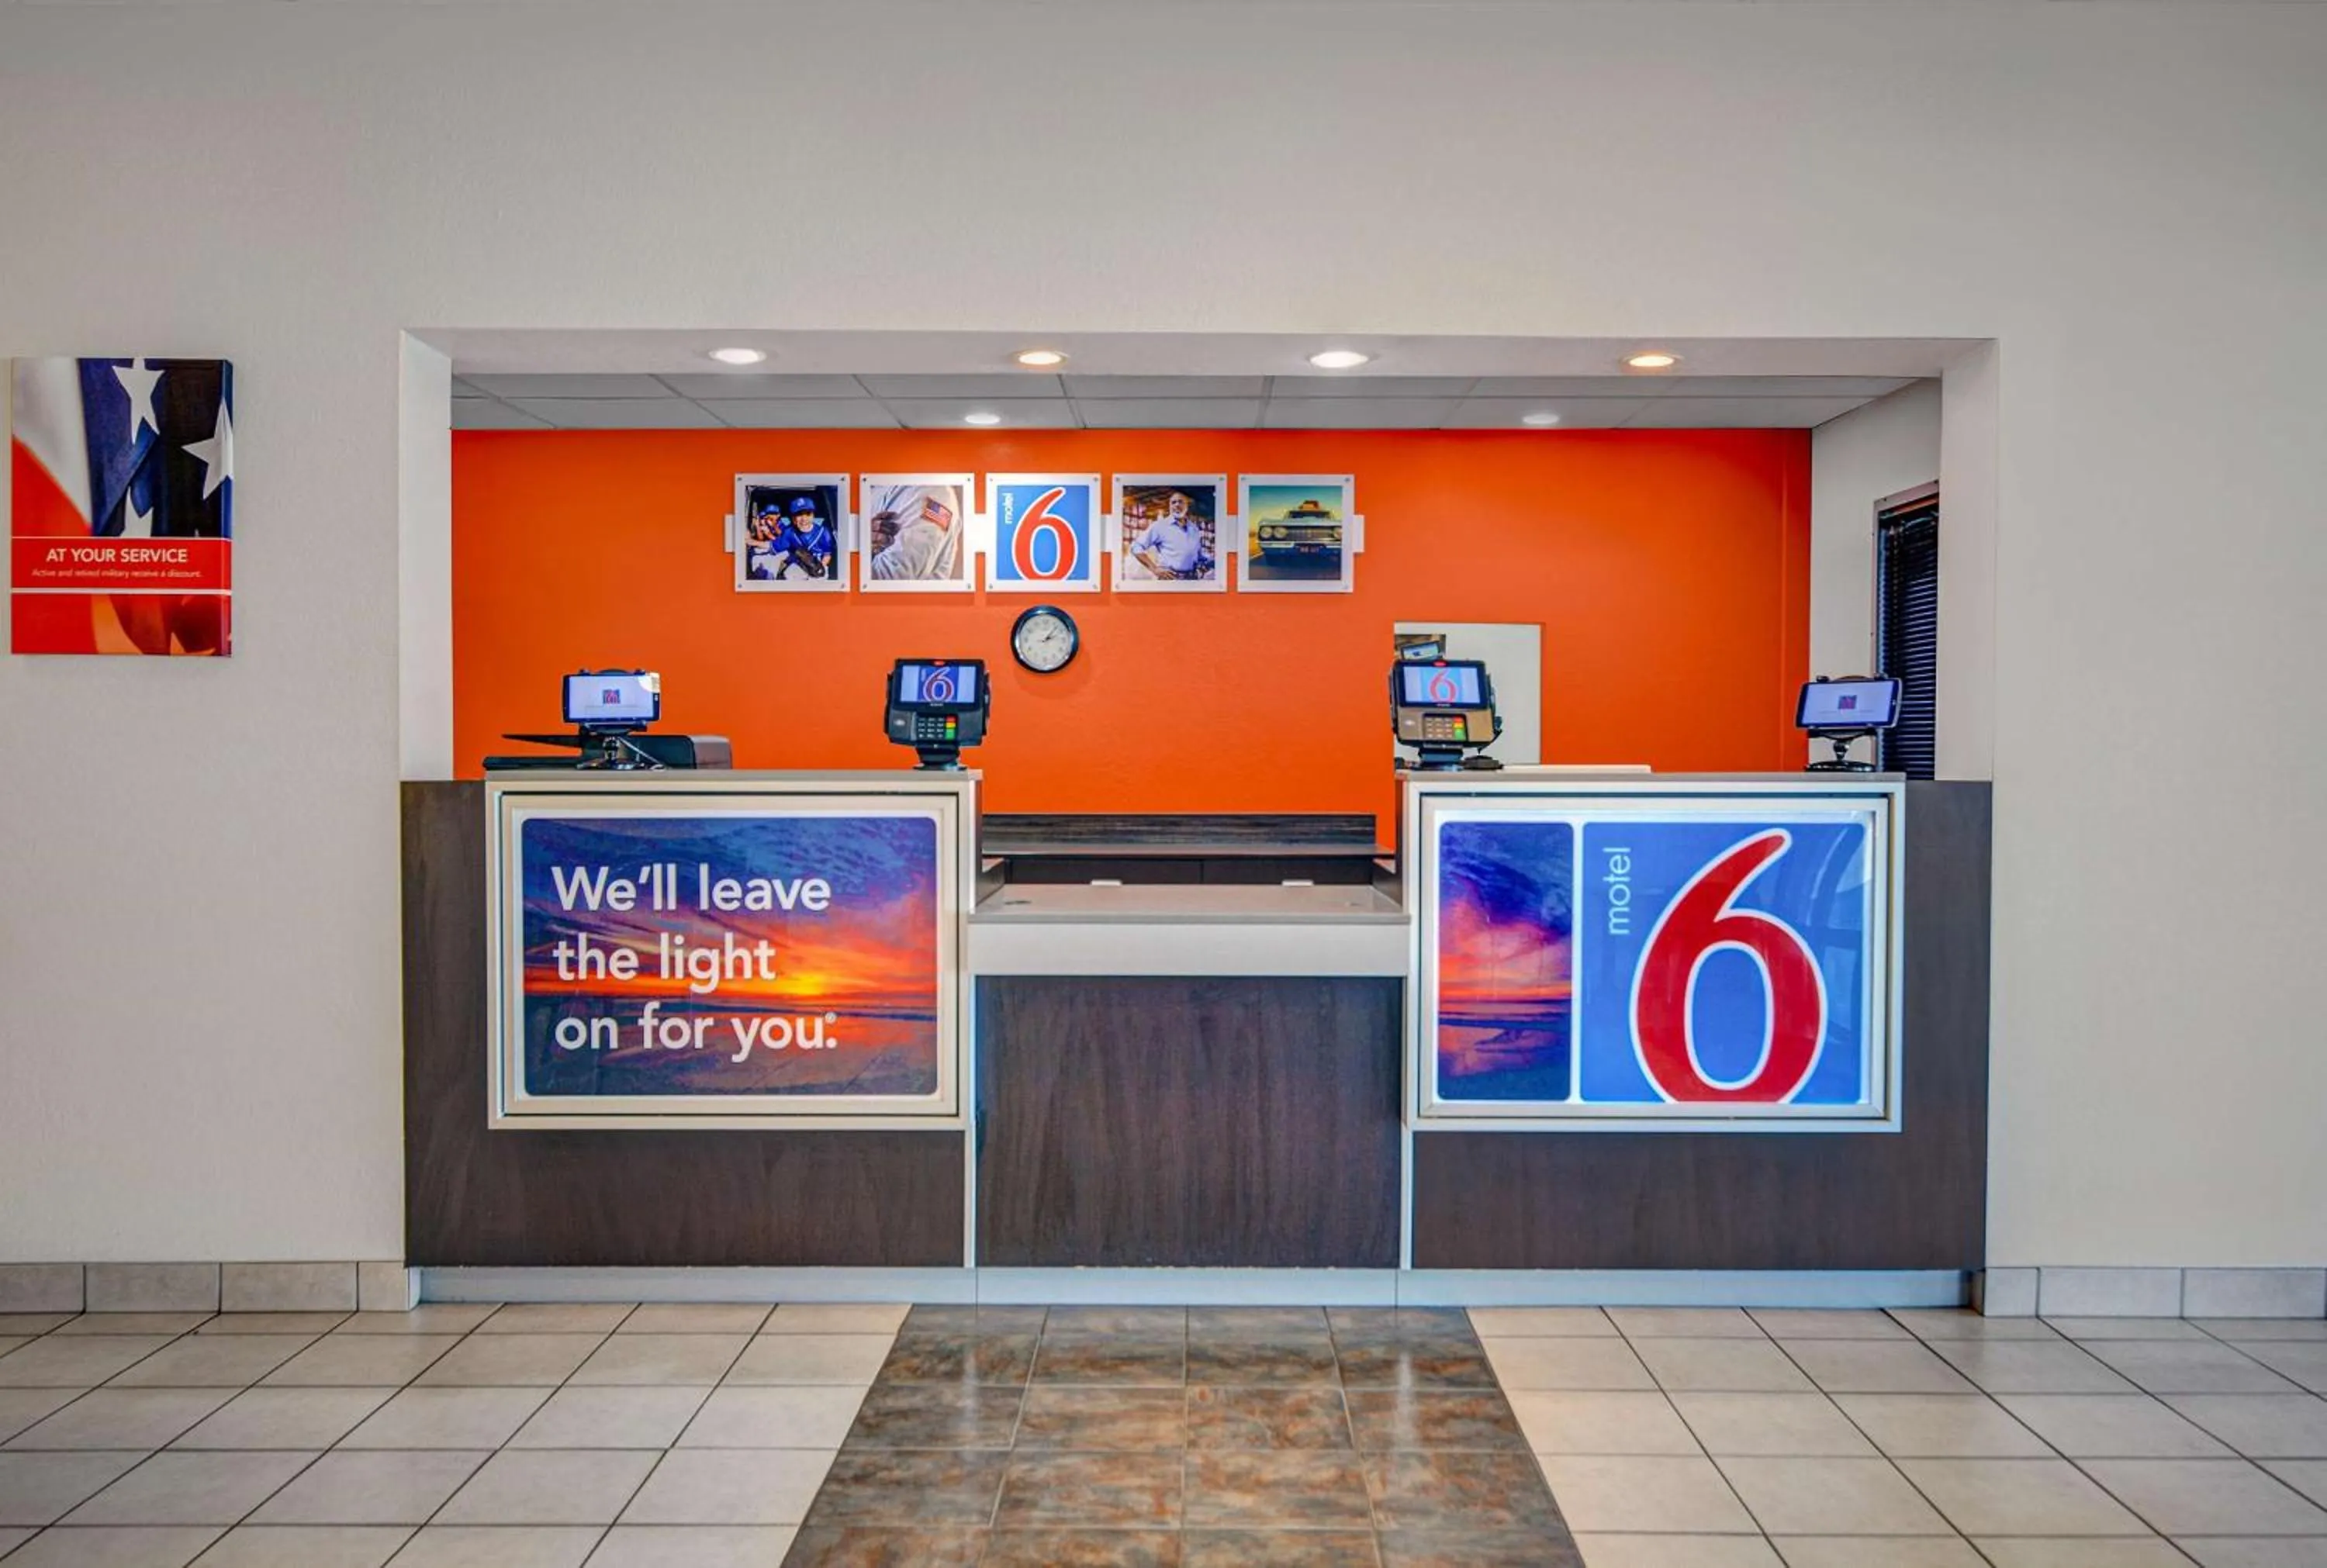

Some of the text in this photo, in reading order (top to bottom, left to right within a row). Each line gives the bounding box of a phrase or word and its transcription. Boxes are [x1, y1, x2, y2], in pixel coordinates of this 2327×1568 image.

[1002, 492, 1014, 524] motel
[46, 548, 188, 563] AT YOUR SERVICE
[1011, 486, 1078, 581] 6
[923, 666, 955, 702] 6
[1430, 668, 1457, 703] 6
[551, 863, 832, 912] We'll leave
[1603, 847, 1631, 934] motel
[552, 931, 776, 995] the light
[1630, 827, 1828, 1103] 6
[555, 1017, 619, 1051] on
[638, 1000, 714, 1050] for
